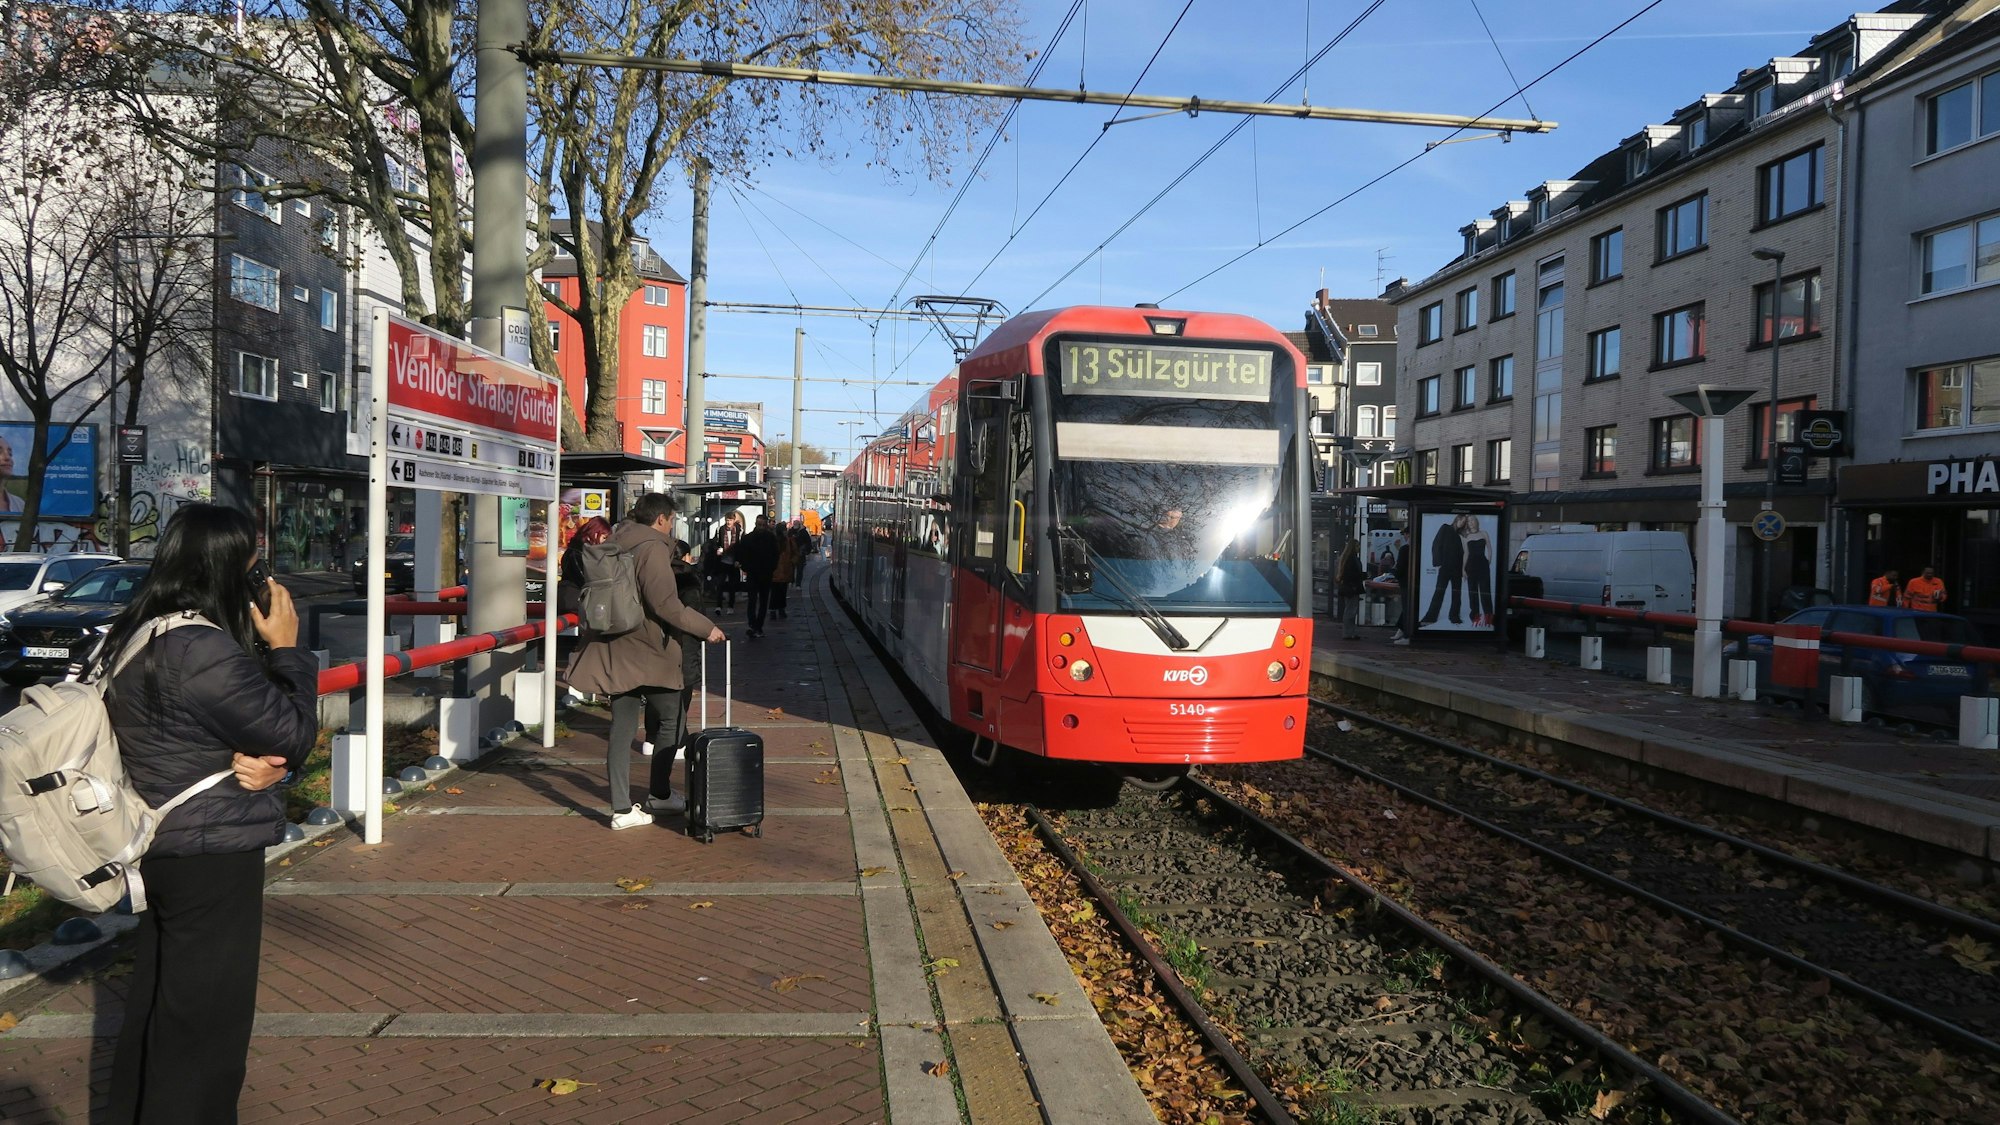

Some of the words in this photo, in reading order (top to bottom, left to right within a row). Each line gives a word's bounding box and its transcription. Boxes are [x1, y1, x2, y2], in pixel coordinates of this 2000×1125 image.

[1070, 346, 1099, 384] 13
[1107, 348, 1266, 389] Sülzgürtel
[394, 341, 464, 401] Venloer
[467, 369, 556, 427] Straße/Gürtel
[710, 410, 748, 420] IMMOBILIEN
[426, 434, 436, 449] 141
[440, 437, 450, 451] 142
[453, 440, 463, 453] 143
[405, 465, 414, 479] 13
[1928, 461, 2000, 494] PHA
[643, 479, 673, 490] KISK
[48, 649, 68, 657] 8758
[1163, 670, 1189, 682] KVB
[1169, 703, 1205, 716] 5140
[1184, 753, 1190, 762] 2
